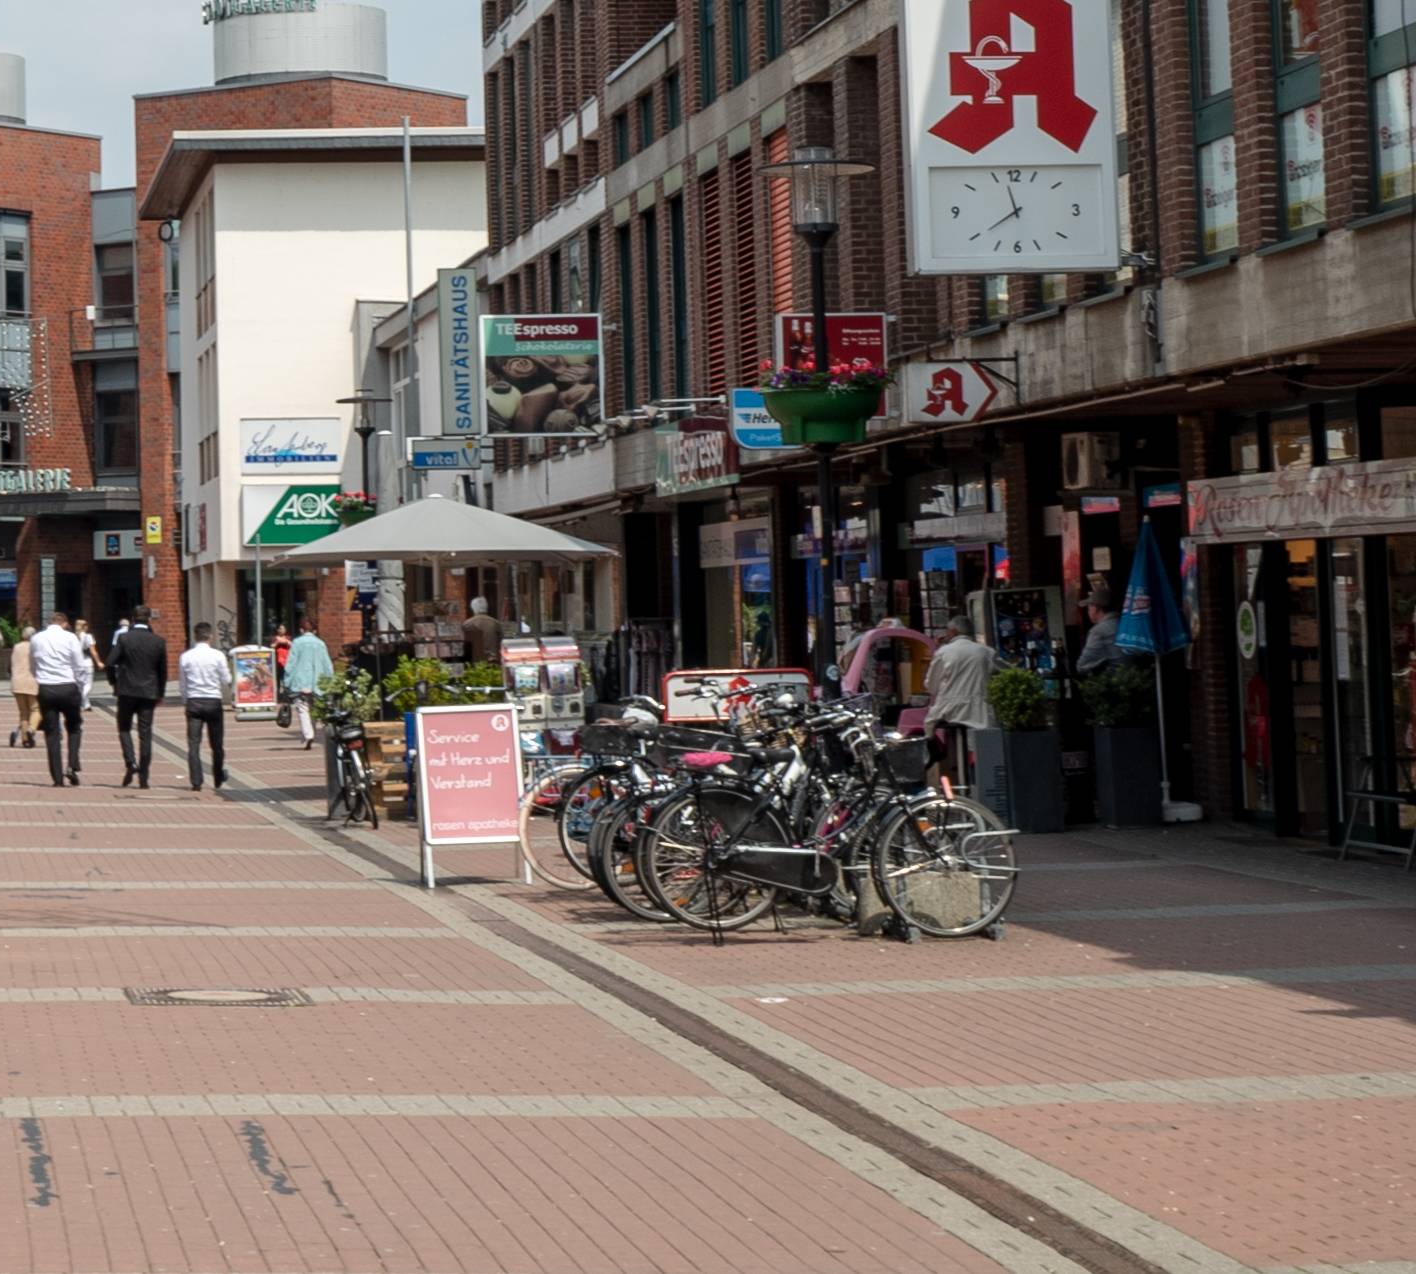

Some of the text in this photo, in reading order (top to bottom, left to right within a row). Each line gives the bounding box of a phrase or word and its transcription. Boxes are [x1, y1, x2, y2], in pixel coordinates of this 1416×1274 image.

[1007, 169, 1021, 182] 12
[951, 206, 960, 219] 9
[1072, 203, 1081, 216] 3
[1013, 241, 1022, 253] 6
[495, 322, 579, 338] TEEspresso
[450, 275, 472, 429] SANITÄTSHAUS
[425, 452, 457, 465] vital
[275, 493, 339, 518] AOK
[427, 729, 480, 744] Service
[429, 748, 510, 767] mit Herz und
[430, 771, 492, 789] Verstand
[432, 818, 518, 832] rosen apotheke
